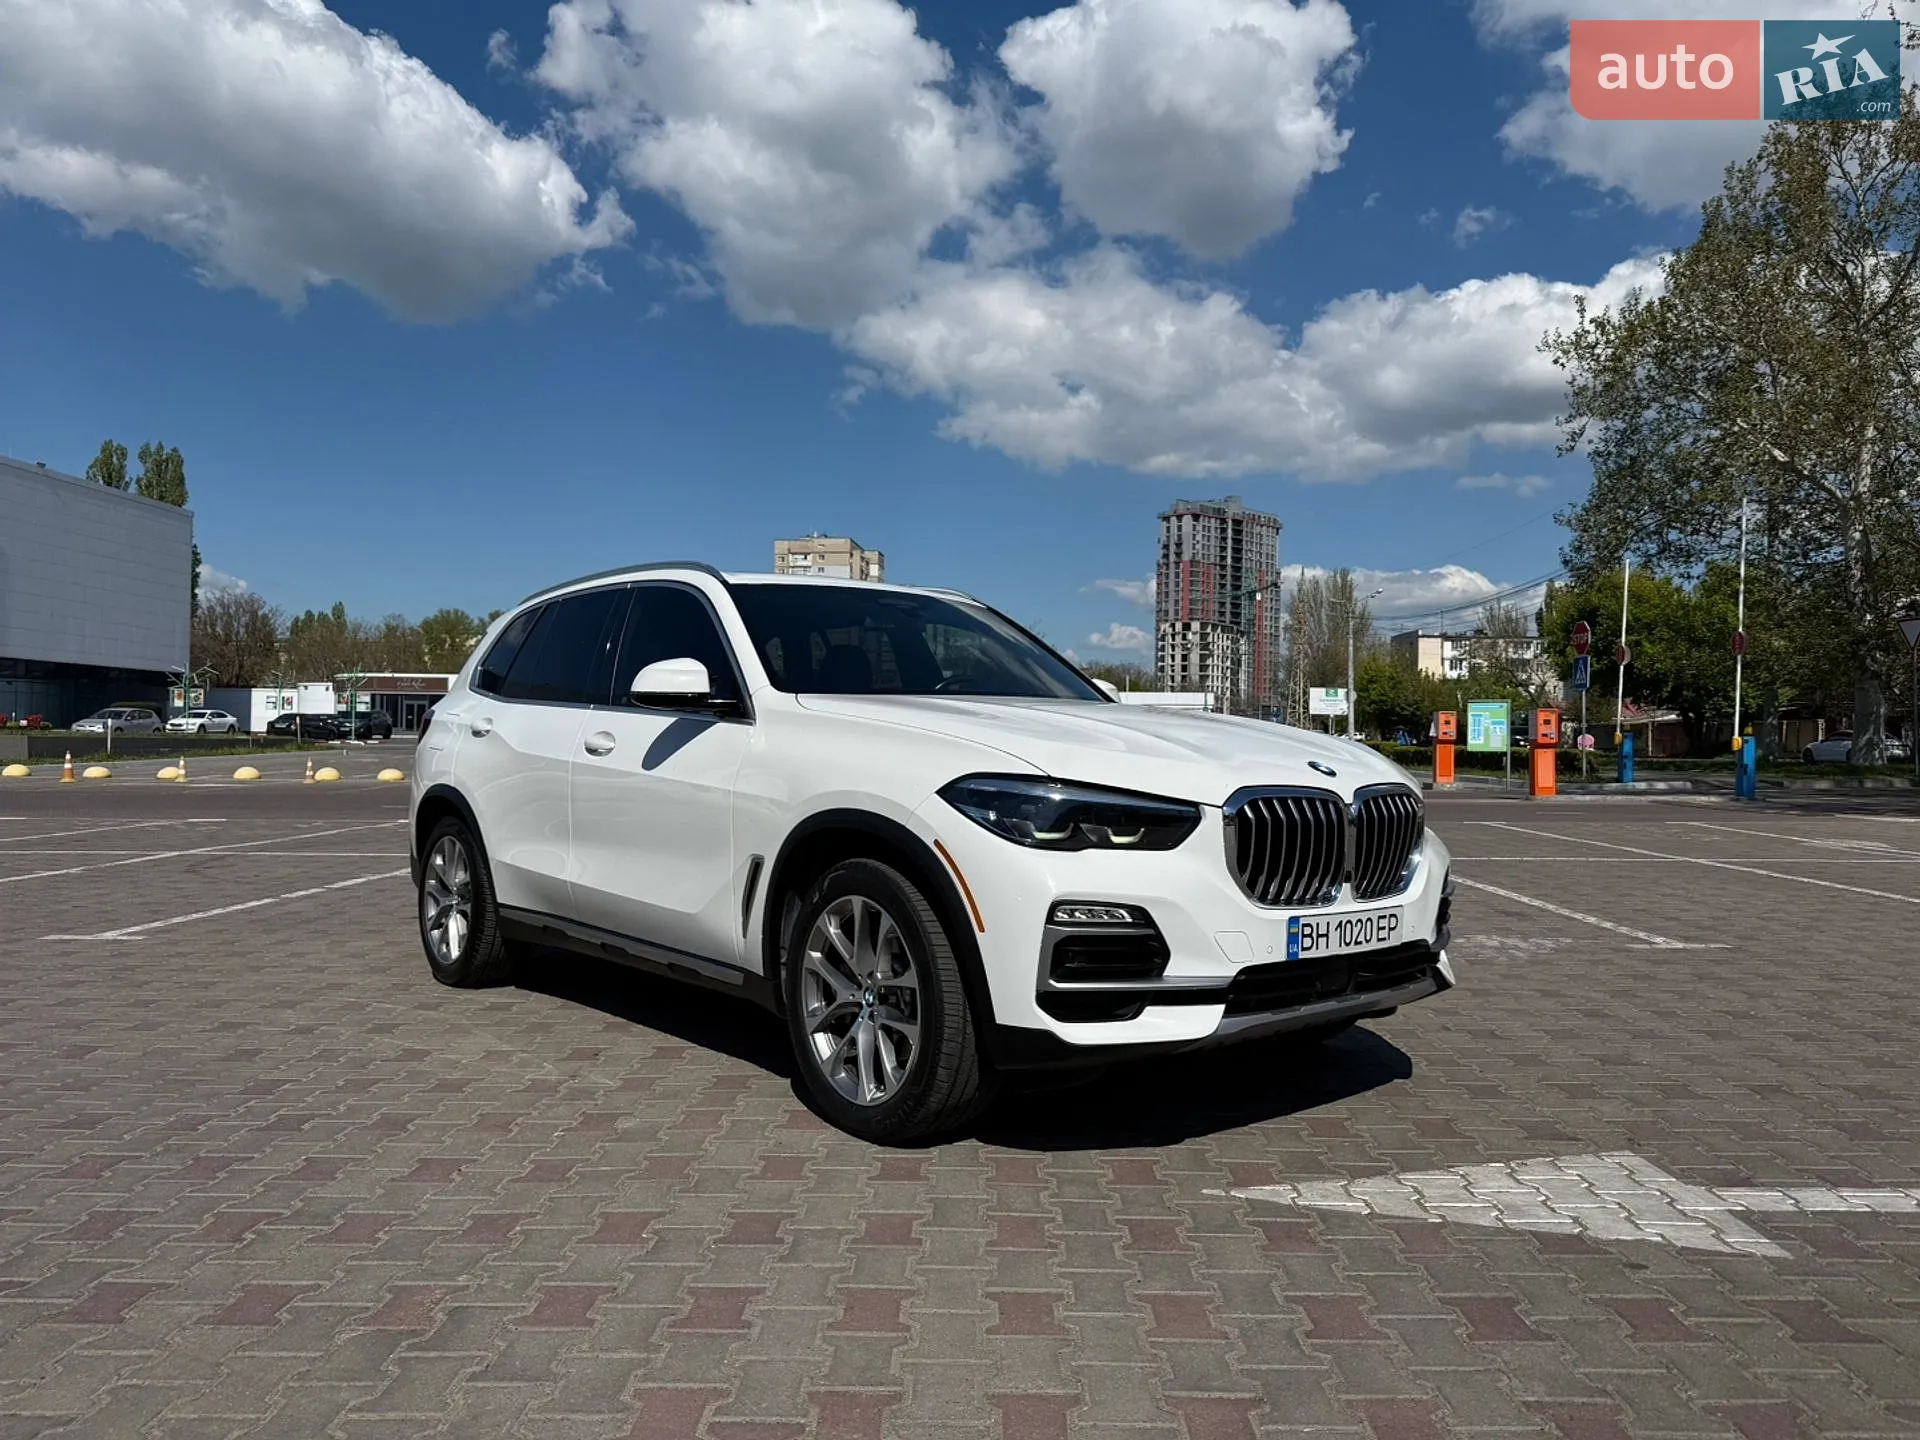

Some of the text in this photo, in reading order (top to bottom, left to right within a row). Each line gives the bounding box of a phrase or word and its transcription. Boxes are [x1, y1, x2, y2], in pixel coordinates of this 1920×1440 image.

[1572, 634, 1588, 645] STOP
[1301, 913, 1399, 952] BH 1020 EP
